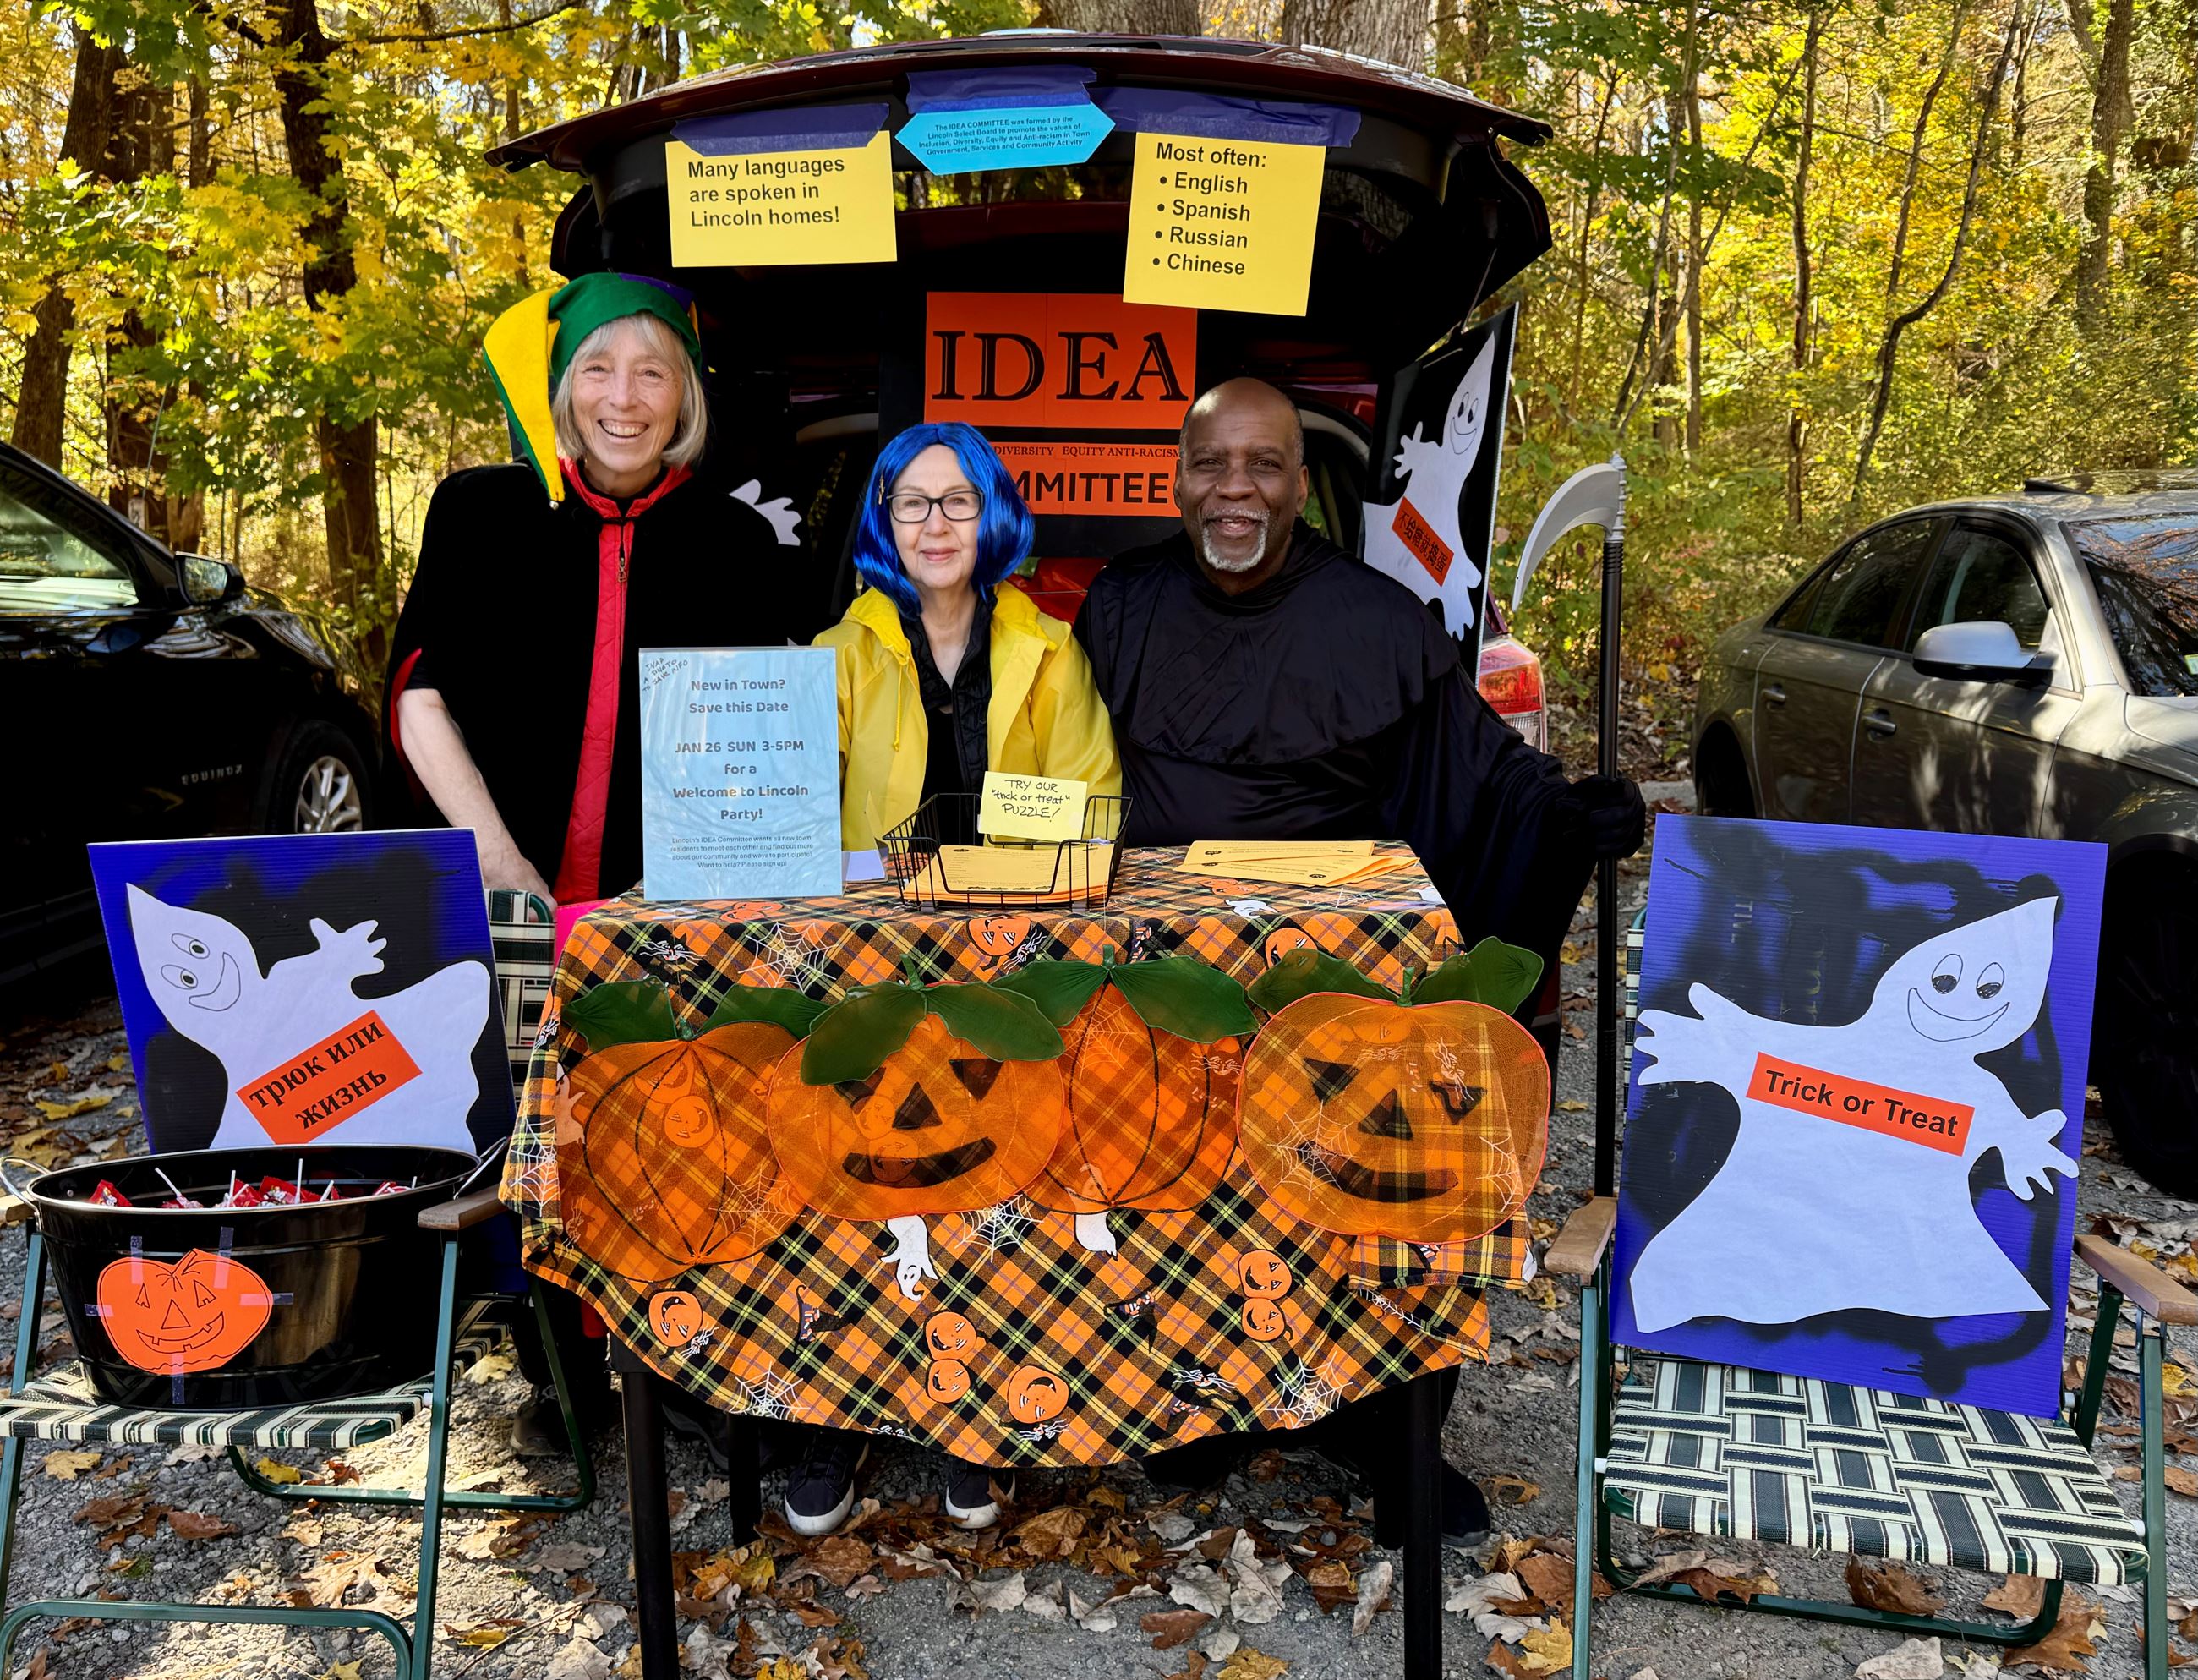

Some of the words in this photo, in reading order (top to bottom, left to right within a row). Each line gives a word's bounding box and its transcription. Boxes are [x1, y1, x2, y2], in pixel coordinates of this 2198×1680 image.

[967, 119, 1009, 129] COMMITTEE
[1007, 126, 1036, 134] promote
[919, 140, 952, 149] Inclusion,
[953, 137, 985, 145] Diversity,
[986, 135, 1007, 144] Equity
[1023, 132, 1063, 141] Anti-racism
[927, 145, 971, 156] Government,
[971, 144, 1000, 152] Services
[1016, 140, 1055, 149] Community
[1156, 141, 1205, 163] Most
[1210, 148, 1267, 168] often:
[687, 161, 739, 180] Many
[745, 158, 845, 178] languages
[689, 188, 719, 203] are
[725, 183, 796, 205] spoken
[802, 182, 819, 200] in
[1174, 171, 1249, 195] English
[691, 209, 763, 227] Lincoln
[768, 205, 840, 226] homes!
[1172, 199, 1251, 222] Spanish
[1169, 226, 1249, 249] Russian
[1167, 253, 1246, 276] Chinese
[932, 331, 1189, 402] IDEA
[993, 446, 1055, 456] DIVERSITY
[1062, 446, 1107, 457] EQUITY
[1014, 470, 1170, 504] MMITTEE
[691, 680, 722, 691] New
[724, 679, 738, 690] in
[741, 679, 786, 690] Town?
[689, 703, 723, 714] Save
[725, 701, 752, 714] this
[756, 702, 789, 713] Date
[675, 742, 702, 753] JAN
[705, 742, 722, 753] 26
[727, 741, 756, 752] SUN
[762, 741, 805, 752] 3-5PM
[181, 763, 243, 785] EQUINOX
[724, 763, 746, 774] for
[749, 766, 757, 774] a
[673, 786, 737, 799] Welcome
[740, 787, 755, 797] to
[758, 785, 809, 796] Lincoln
[1004, 779, 1031, 791] TRY
[1036, 781, 1058, 793] OUR
[720, 808, 763, 822] Party!
[1001, 802, 1061, 823] PUZZLE!
[249, 1055, 327, 1108] трюк
[324, 1021, 385, 1065] или
[294, 1070, 388, 1130] жизнь
[1765, 1069, 1836, 1108] Trick
[1843, 1094, 1875, 1116] or
[1884, 1097, 1959, 1138] Treat
